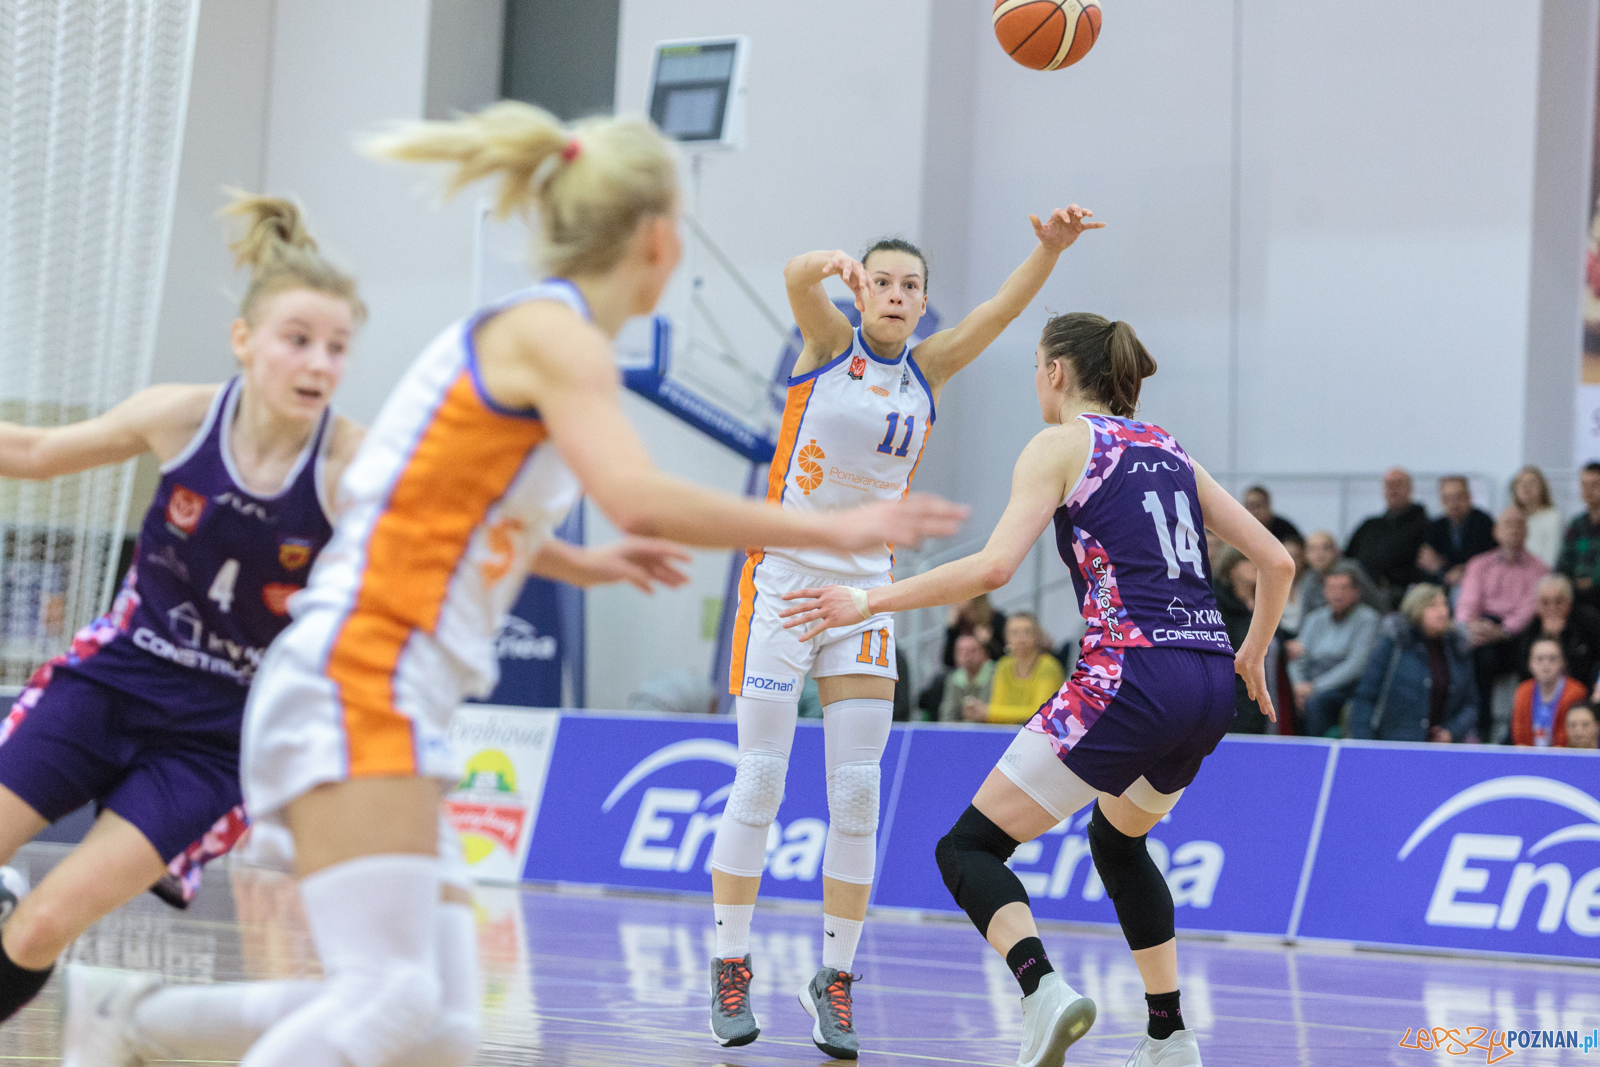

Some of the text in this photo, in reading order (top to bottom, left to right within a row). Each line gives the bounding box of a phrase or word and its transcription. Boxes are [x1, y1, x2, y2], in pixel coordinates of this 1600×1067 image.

[876, 411, 915, 458] 11
[1142, 490, 1205, 579] 14
[207, 558, 240, 613] 4
[1092, 557, 1123, 642] BYDGOSZCZ
[856, 626, 889, 668] 11
